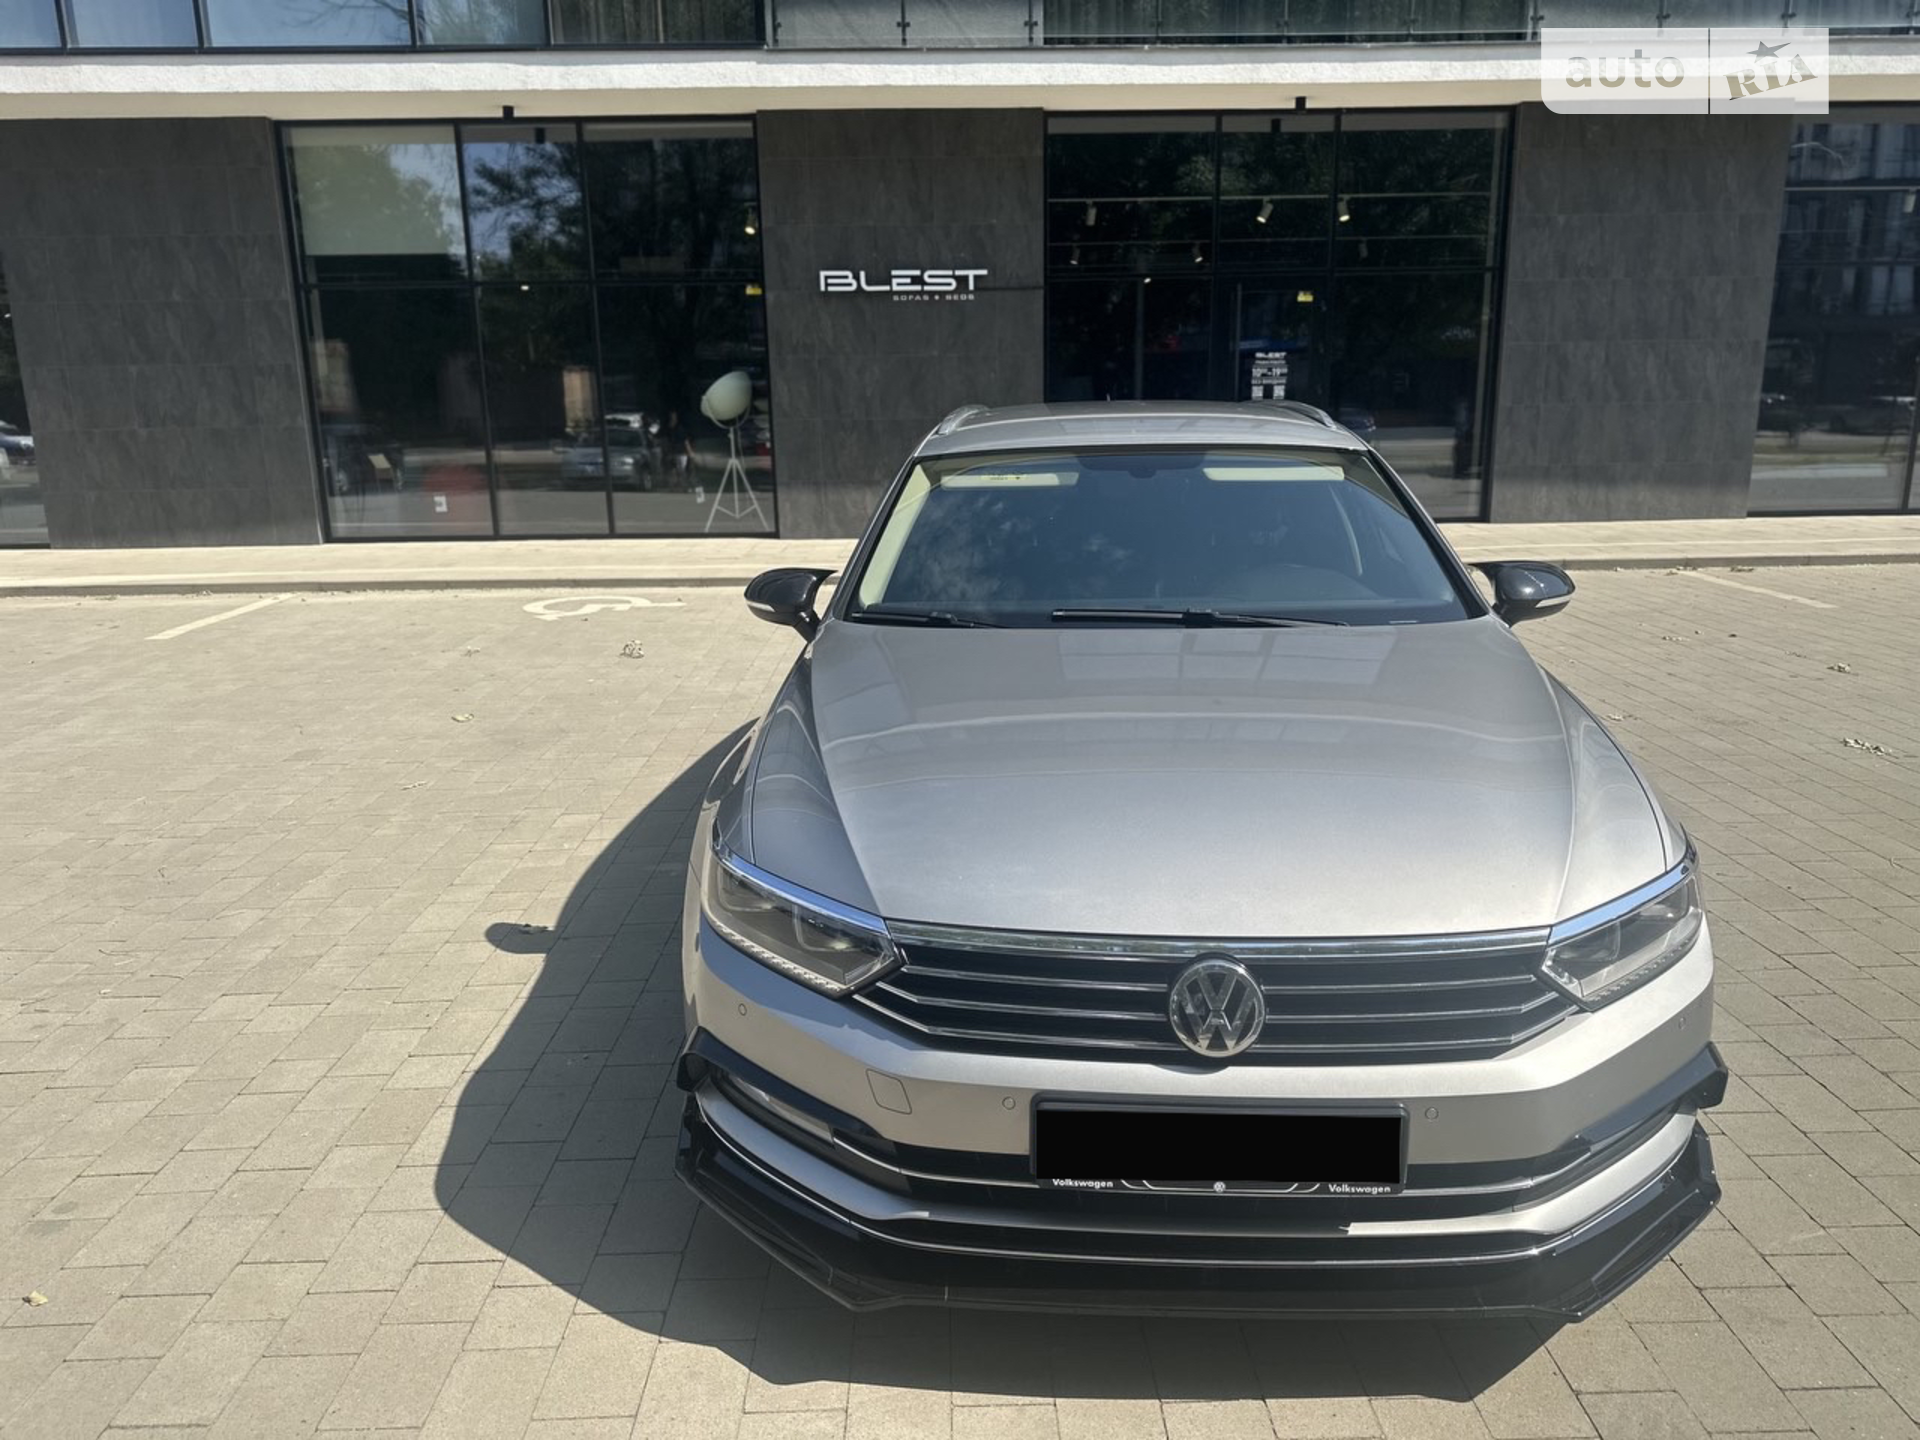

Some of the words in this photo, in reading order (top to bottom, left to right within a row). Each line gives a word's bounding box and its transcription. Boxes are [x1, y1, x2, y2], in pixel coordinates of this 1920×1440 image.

[819, 269, 988, 292] BLEST
[1052, 1178, 1114, 1190] Volkswagen
[1328, 1183, 1391, 1195] Volkswagen
